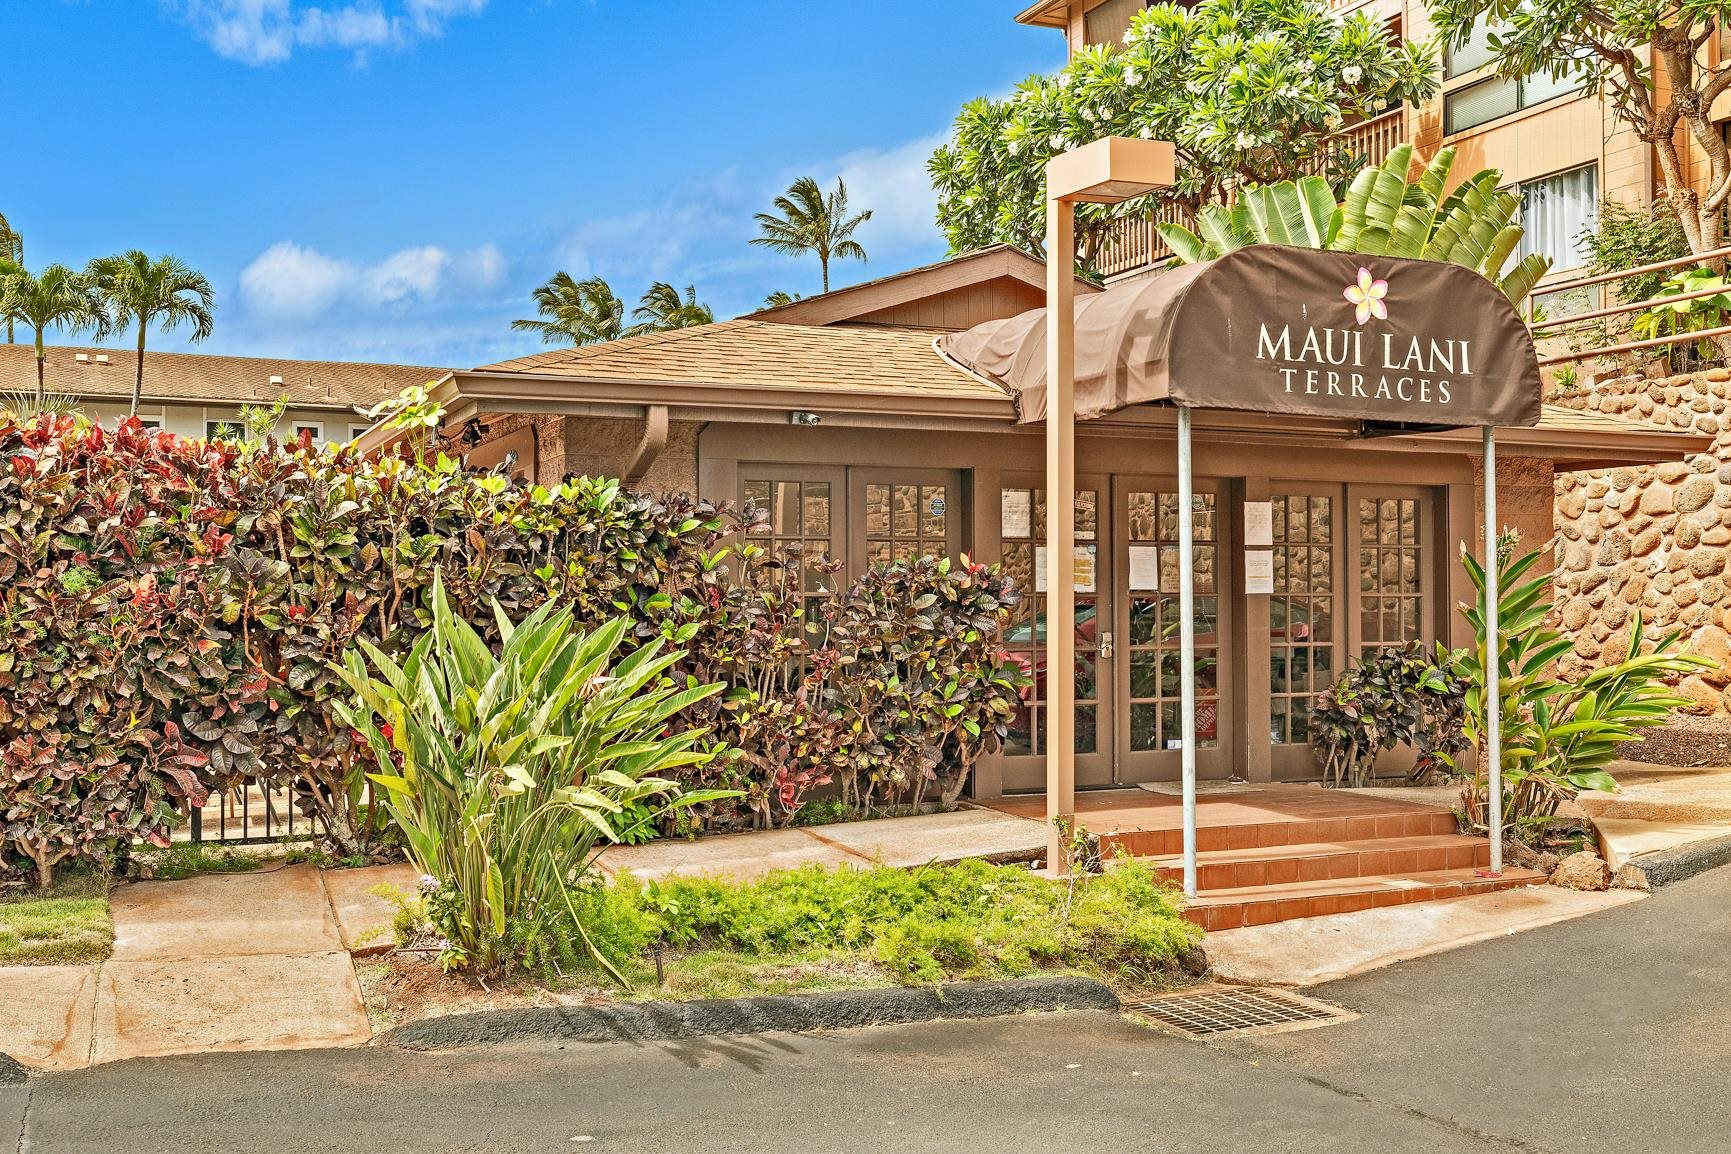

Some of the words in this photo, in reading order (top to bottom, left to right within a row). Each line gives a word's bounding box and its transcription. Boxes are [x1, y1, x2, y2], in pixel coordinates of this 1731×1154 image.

[1255, 322, 1365, 367] MAUI
[1380, 333, 1474, 376] LANI
[1278, 368, 1453, 404] TERRACES
